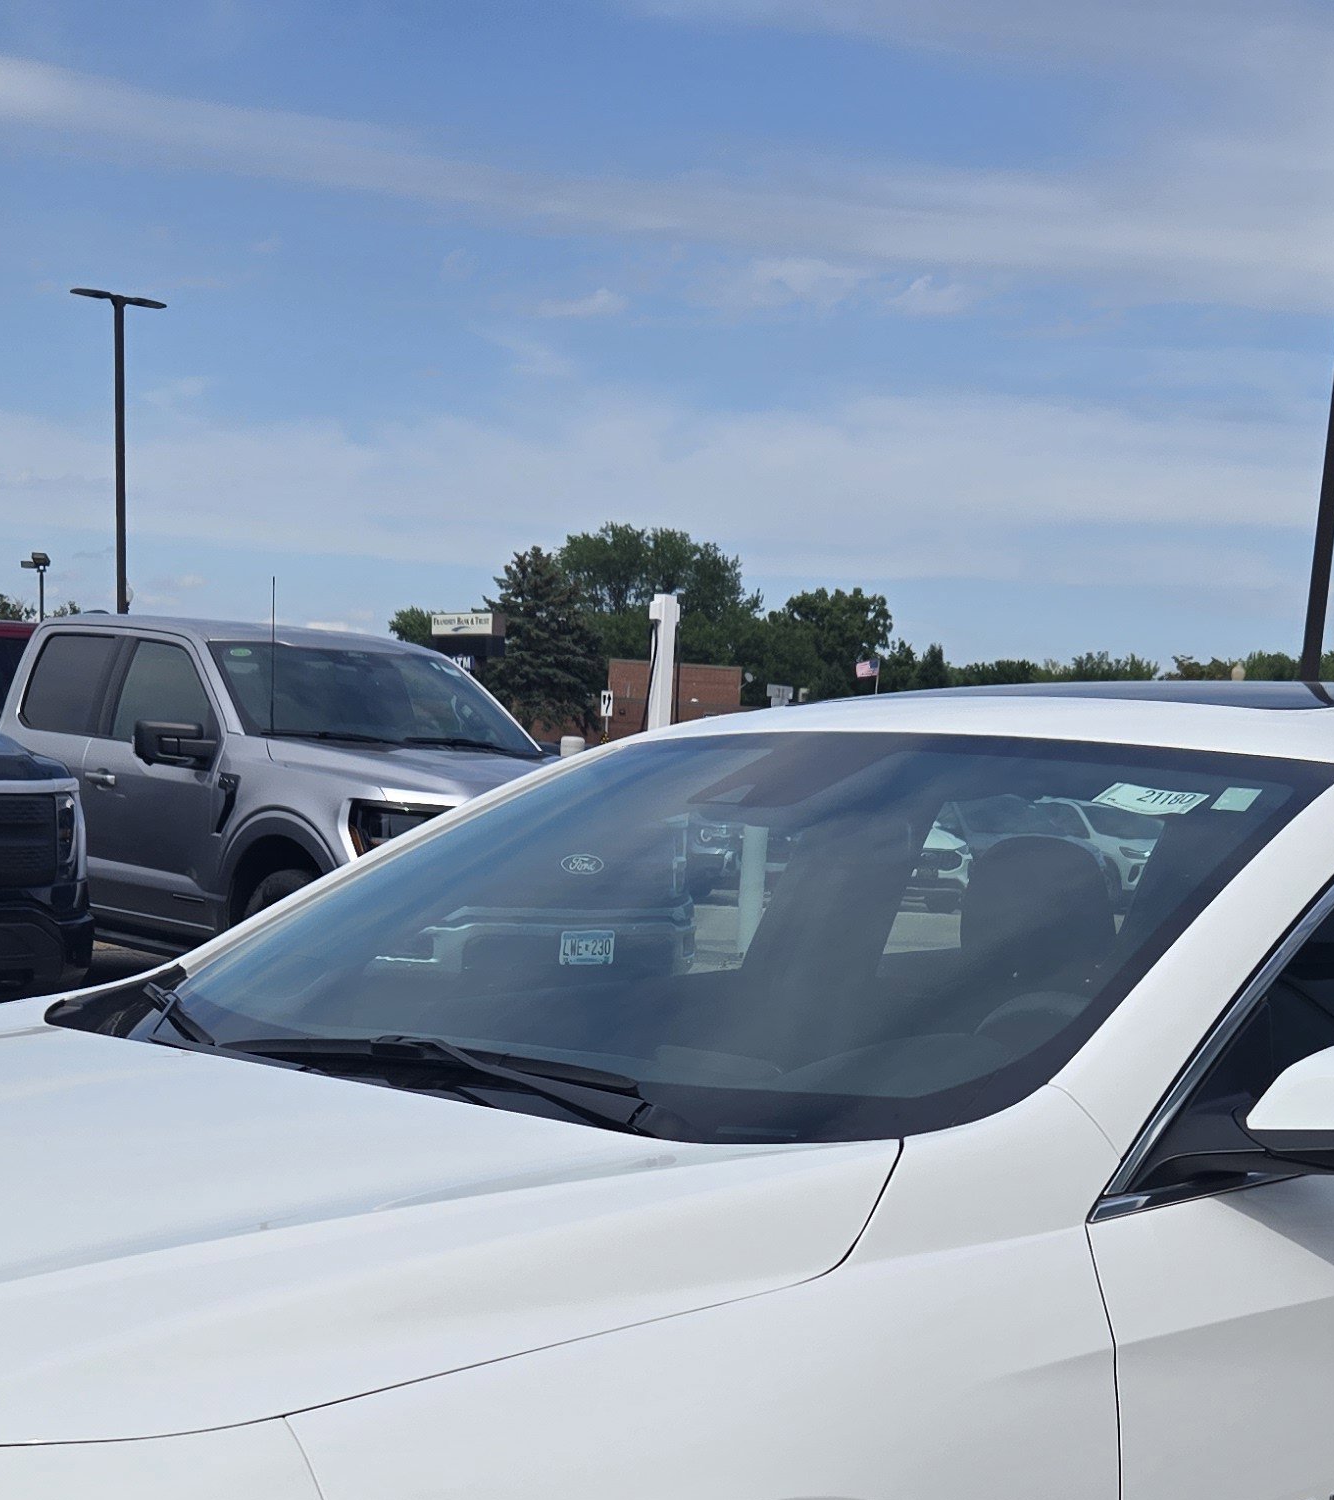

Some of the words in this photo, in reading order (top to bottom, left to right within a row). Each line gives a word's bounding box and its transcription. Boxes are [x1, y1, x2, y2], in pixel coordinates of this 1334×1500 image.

[568, 857, 597, 871] Ford
[563, 940, 583, 956] LWE
[591, 939, 611, 956] 230
